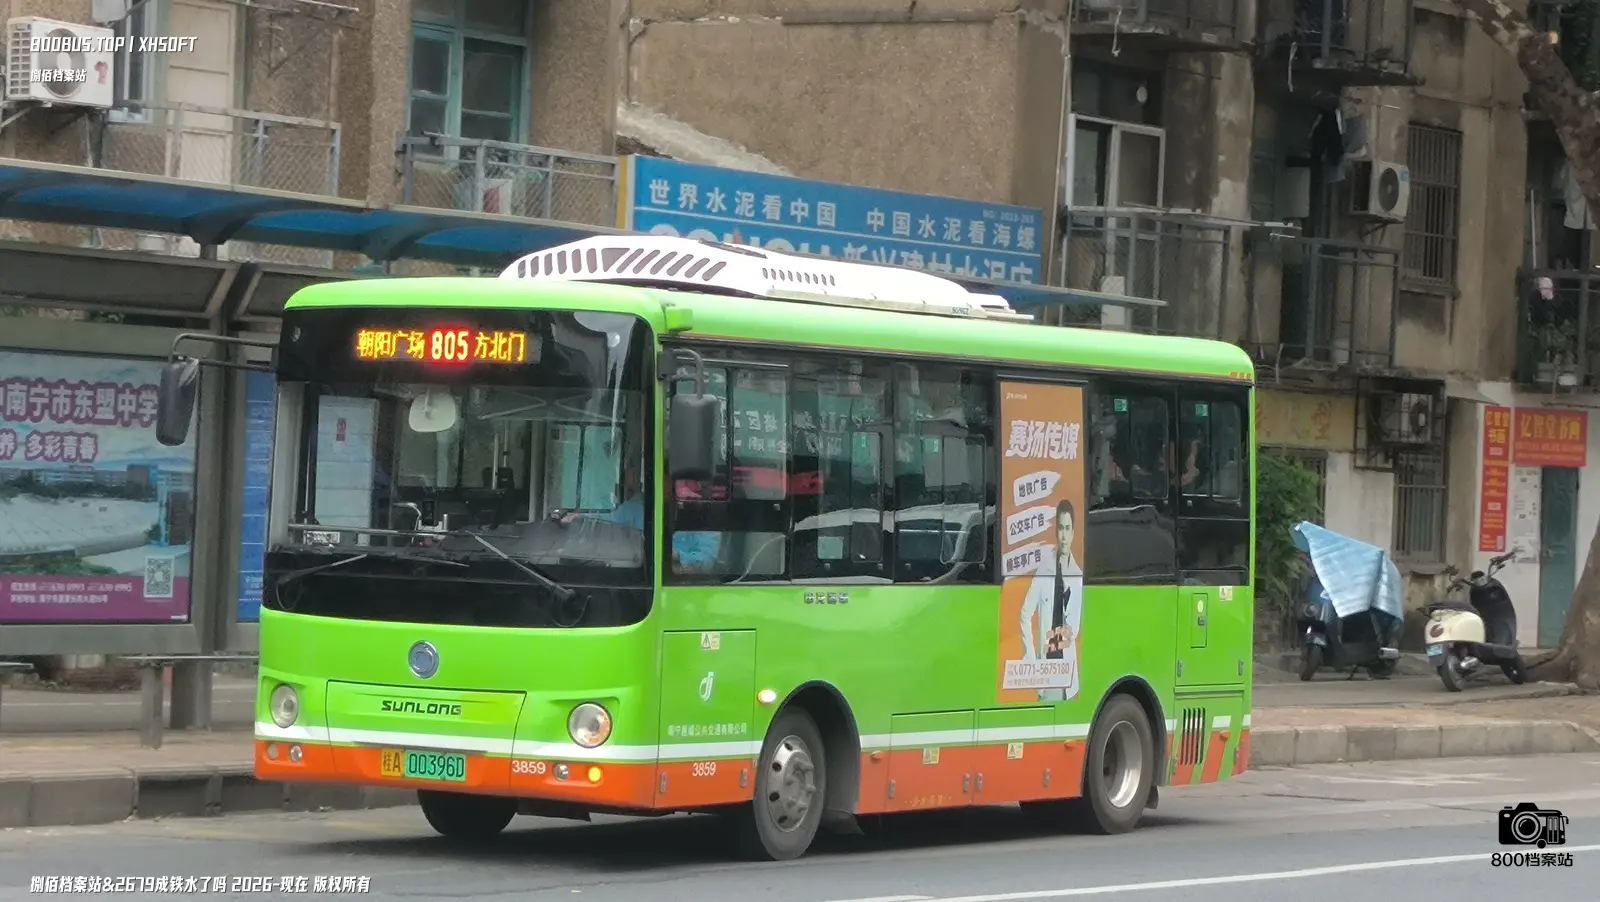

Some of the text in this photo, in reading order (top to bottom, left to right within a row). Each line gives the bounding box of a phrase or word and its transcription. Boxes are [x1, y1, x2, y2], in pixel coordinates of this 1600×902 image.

[649, 178, 837, 229] 世界水泥看中国
[866, 207, 1035, 250] 中国水泥看海螺
[357, 329, 526, 362] 朝阳广场 805 方北门
[0, 382, 158, 423] 南宁市东盟中学
[27, 433, 96, 460] 多彩青春
[1018, 477, 1048, 498] 地铁广告
[1009, 512, 1045, 536] 公交车广告
[381, 700, 462, 716] SUNLONG
[511, 760, 546, 775] 3859
[692, 761, 717, 777] 3859
